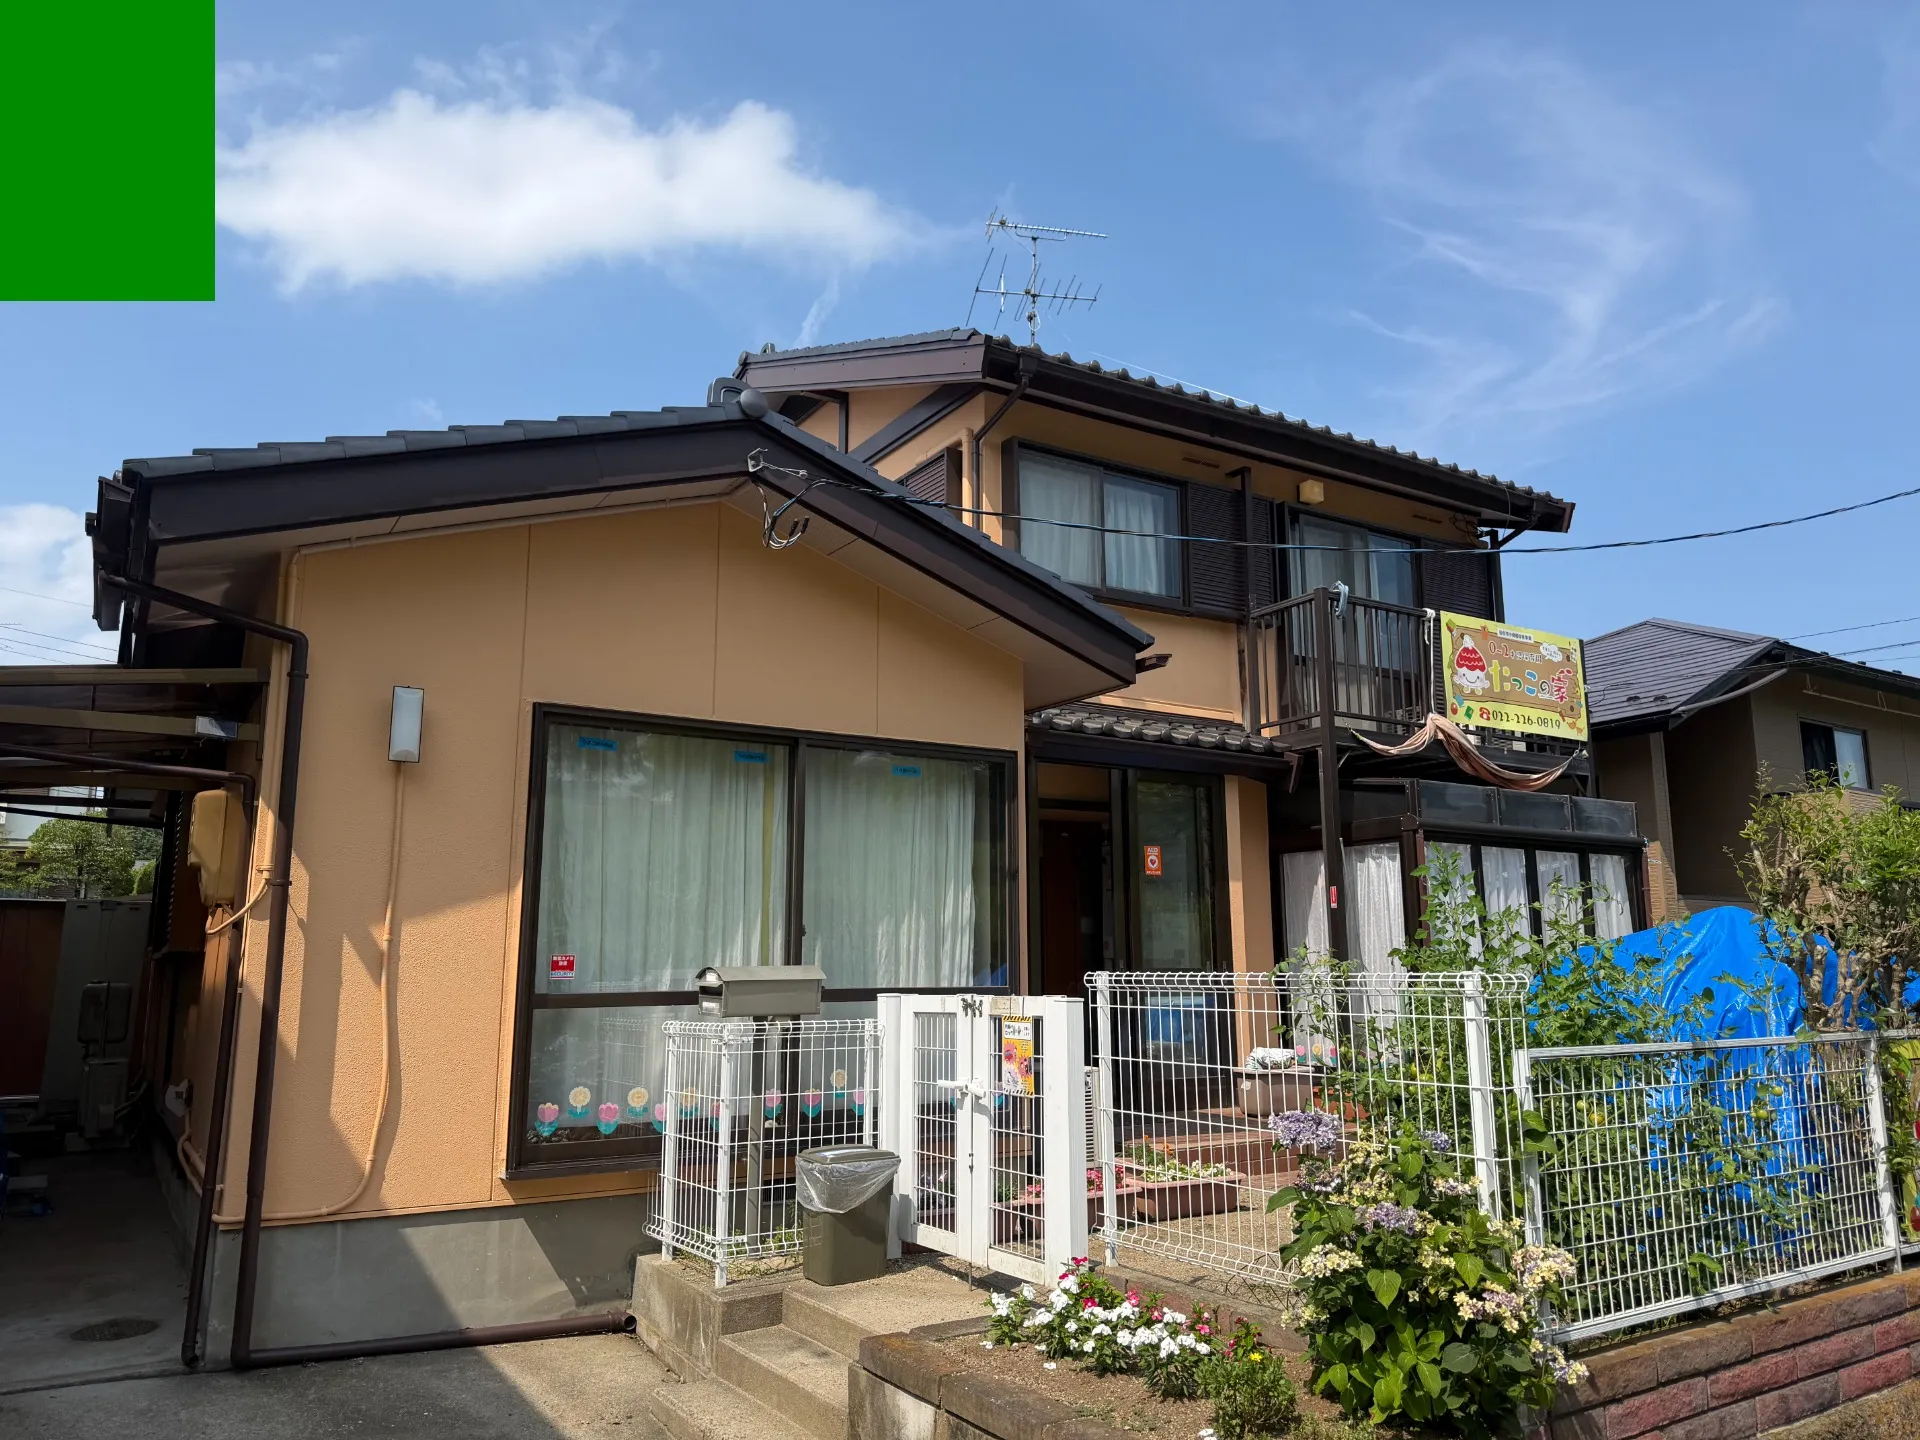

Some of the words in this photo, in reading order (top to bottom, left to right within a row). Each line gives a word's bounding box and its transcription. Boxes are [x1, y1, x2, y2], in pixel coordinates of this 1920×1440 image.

[1488, 659, 1574, 704] たっこの家
[1492, 710, 1561, 729] 022-226-0819
